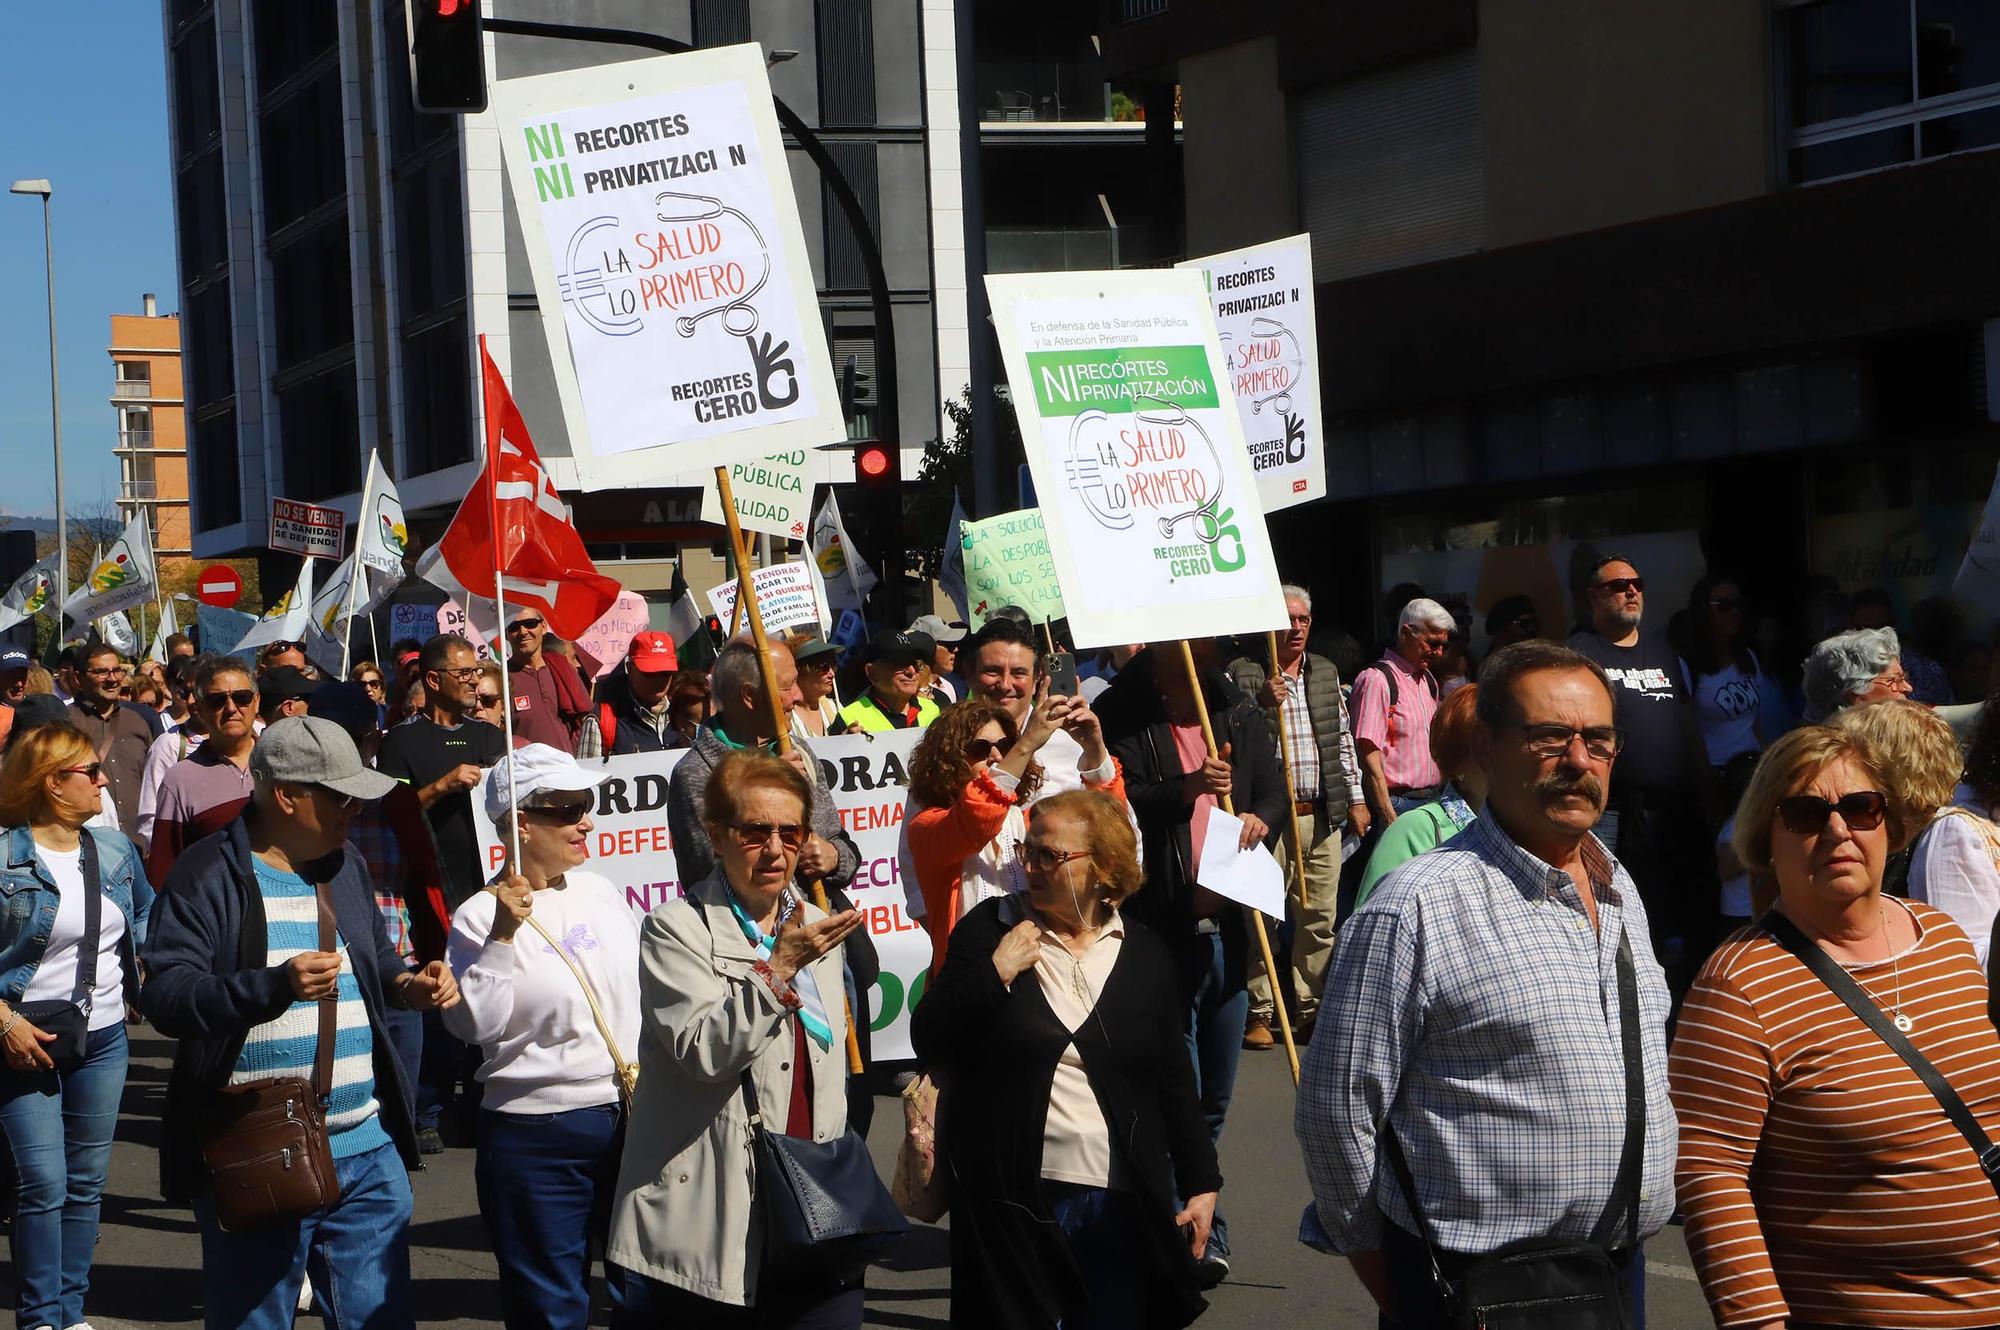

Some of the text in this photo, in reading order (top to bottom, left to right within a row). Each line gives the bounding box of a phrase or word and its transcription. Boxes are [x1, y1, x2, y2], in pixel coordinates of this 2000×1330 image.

[524, 113, 690, 162] NI RECORTES
[534, 162, 575, 203] NI
[603, 222, 721, 274] LA SALUD
[608, 261, 746, 317] LO PRIMERO
[1202, 266, 1275, 293] I RECORTES
[1030, 316, 1189, 333] En defensa de la Sanidad Pública
[1034, 334, 1138, 350] y la Atención Primaria
[1238, 338, 1281, 369] SALUD
[1077, 360, 1169, 380] RECORTES
[671, 371, 753, 402] RECORTES
[1041, 363, 1080, 403] NI
[1080, 376, 1207, 400] PRIVATIZACIÓN
[1236, 366, 1289, 397] PRIMERO
[694, 390, 758, 423] CERO
[765, 449, 806, 466] AD
[1097, 428, 1185, 469] LA SALUD
[1247, 439, 1284, 456] ECORTES
[1253, 450, 1284, 473] CERO
[733, 462, 803, 493] PÚBLICA
[1104, 468, 1206, 510] LO PRIMERO
[276, 502, 341, 527] NO SE VENDE
[275, 530, 338, 547] SE DEFIENDE
[276, 520, 339, 537] LA SANIDAD
[1154, 543, 1206, 560] RECORTES
[974, 555, 992, 571] LA
[1170, 557, 1211, 577] CERO
[775, 583, 813, 596] QUIERES
[782, 575, 795, 584] TU
[976, 577, 1000, 592] SON
[1009, 570, 1032, 585] LOS
[768, 595, 804, 608] ATIENDA
[772, 607, 783, 616] DE
[764, 611, 811, 630] PECIALISTA
[2, 651, 27, 660] adidas
[598, 827, 675, 858] DEFE
